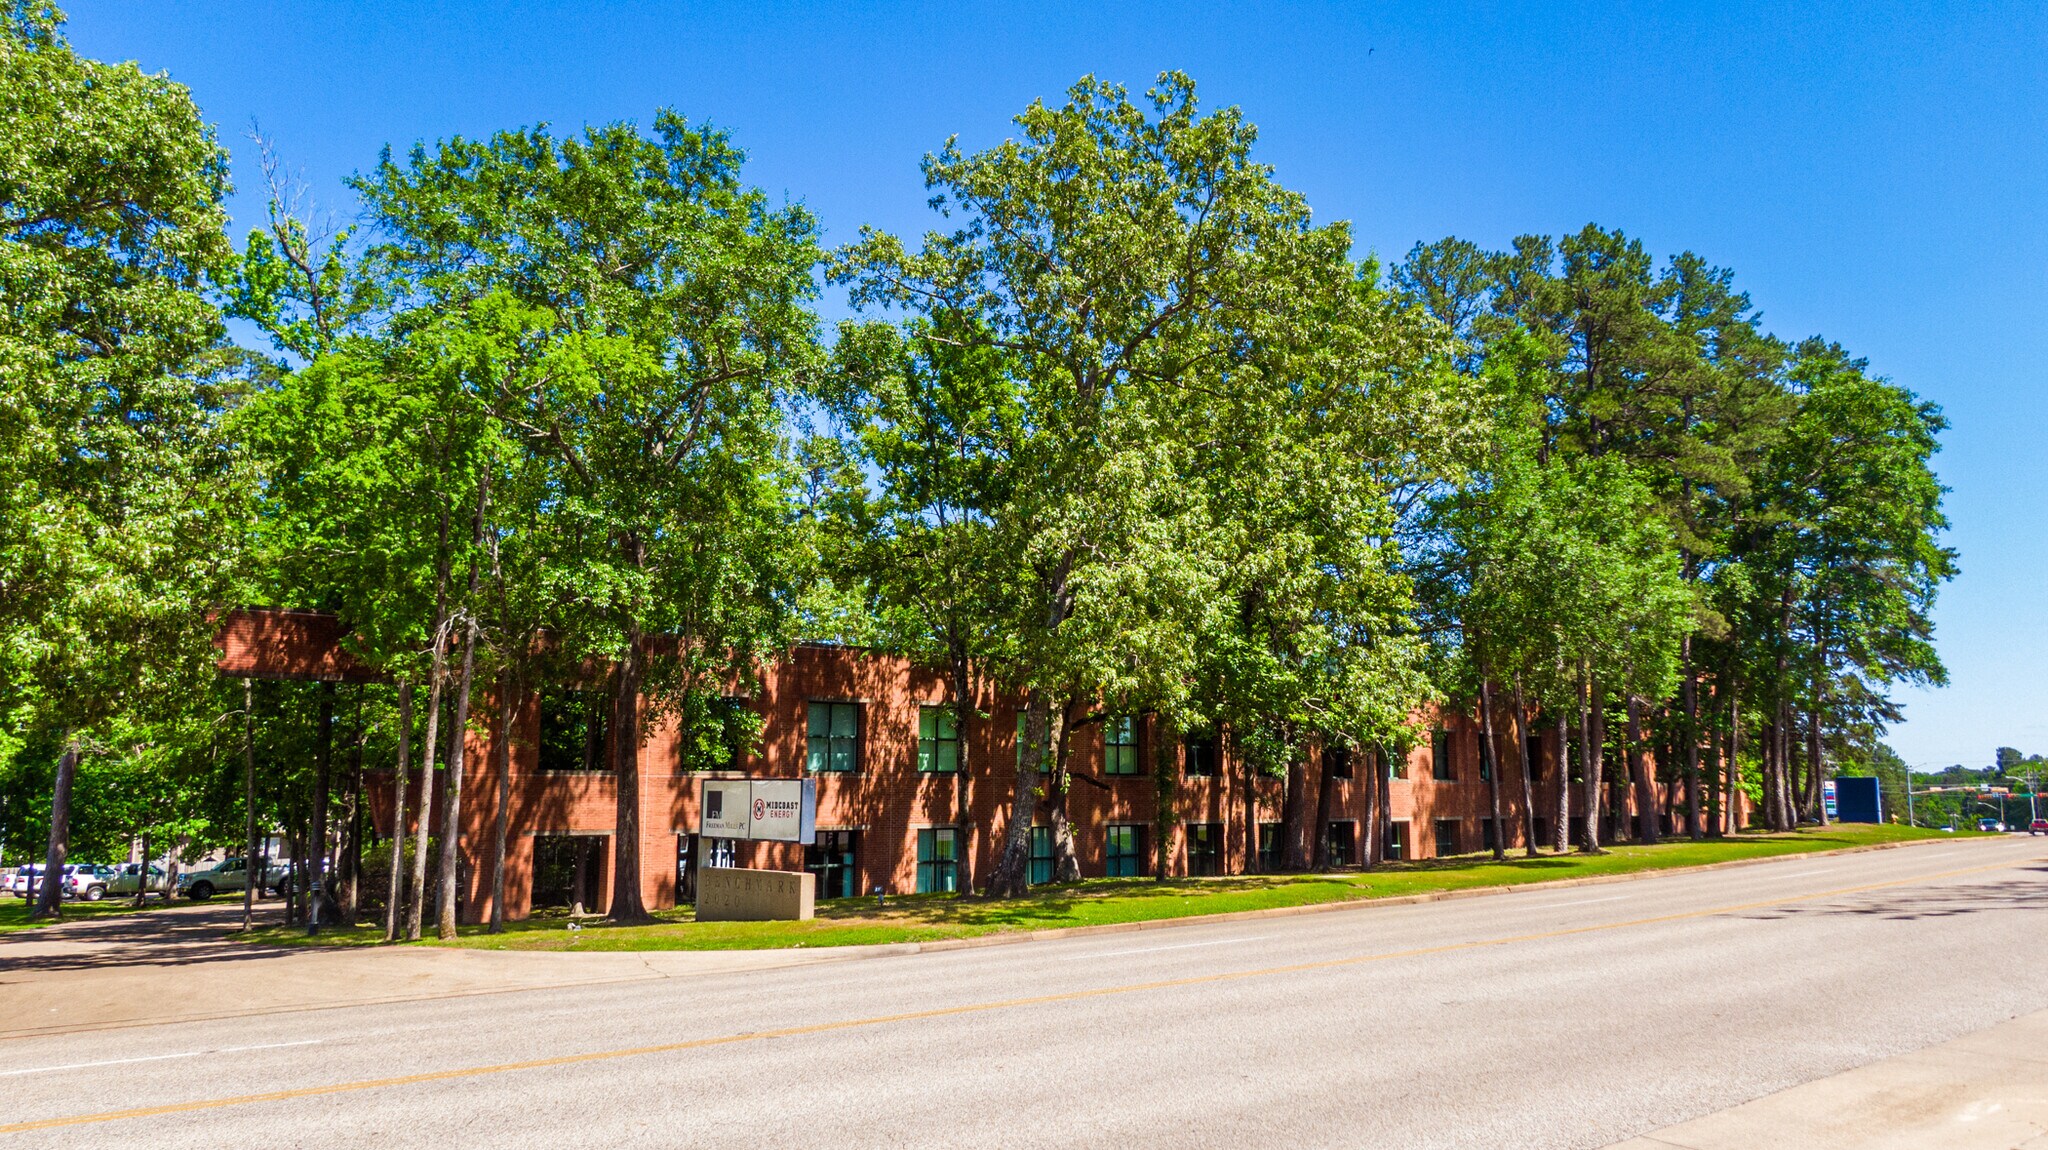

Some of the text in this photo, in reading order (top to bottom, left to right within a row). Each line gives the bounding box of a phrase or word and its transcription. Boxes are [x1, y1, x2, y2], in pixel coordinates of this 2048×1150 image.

[766, 801, 799, 810] MIDCOAST
[770, 810, 794, 818] ENERGY
[704, 893, 740, 907] 2020
